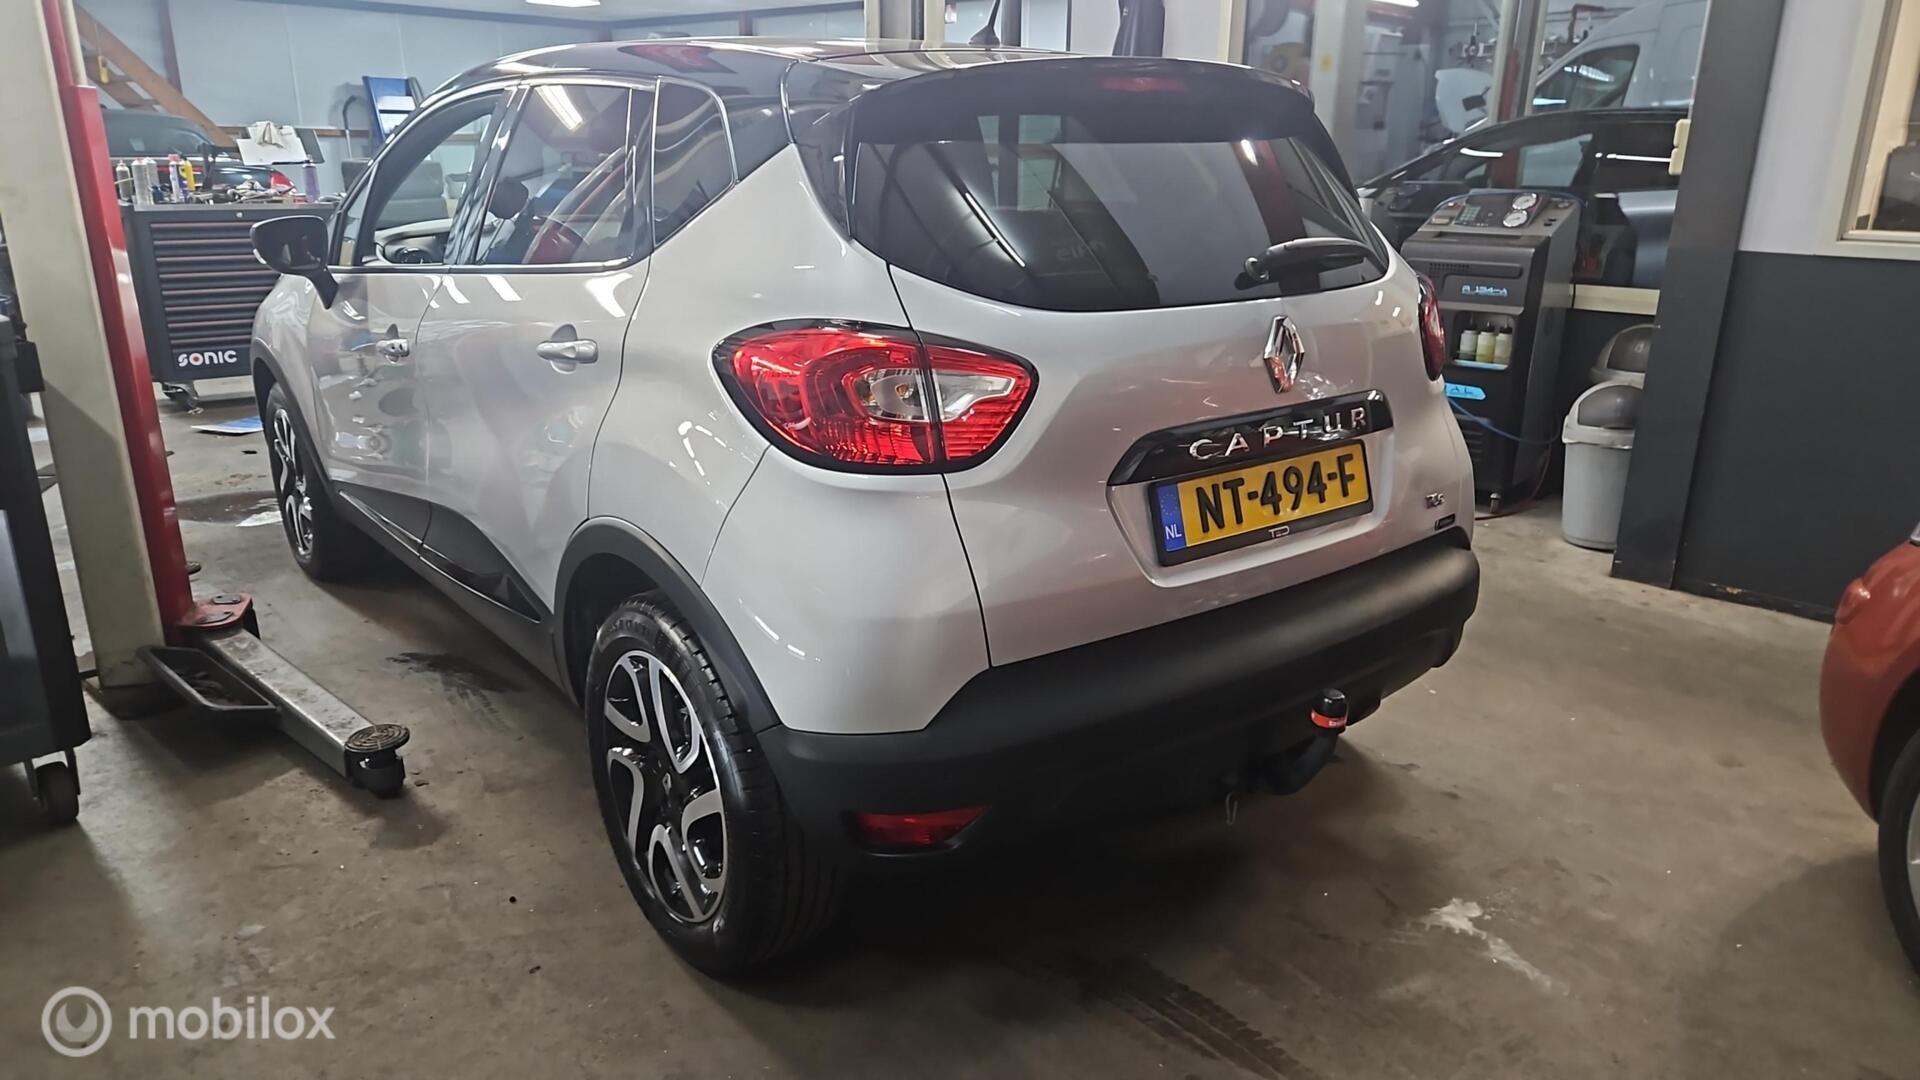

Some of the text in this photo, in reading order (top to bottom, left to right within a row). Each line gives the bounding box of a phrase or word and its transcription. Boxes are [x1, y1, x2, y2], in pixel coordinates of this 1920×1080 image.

[1189, 407, 1366, 460] CAPTUR
[1196, 453, 1356, 533] NT-494-F
[1165, 525, 1182, 539] NL
